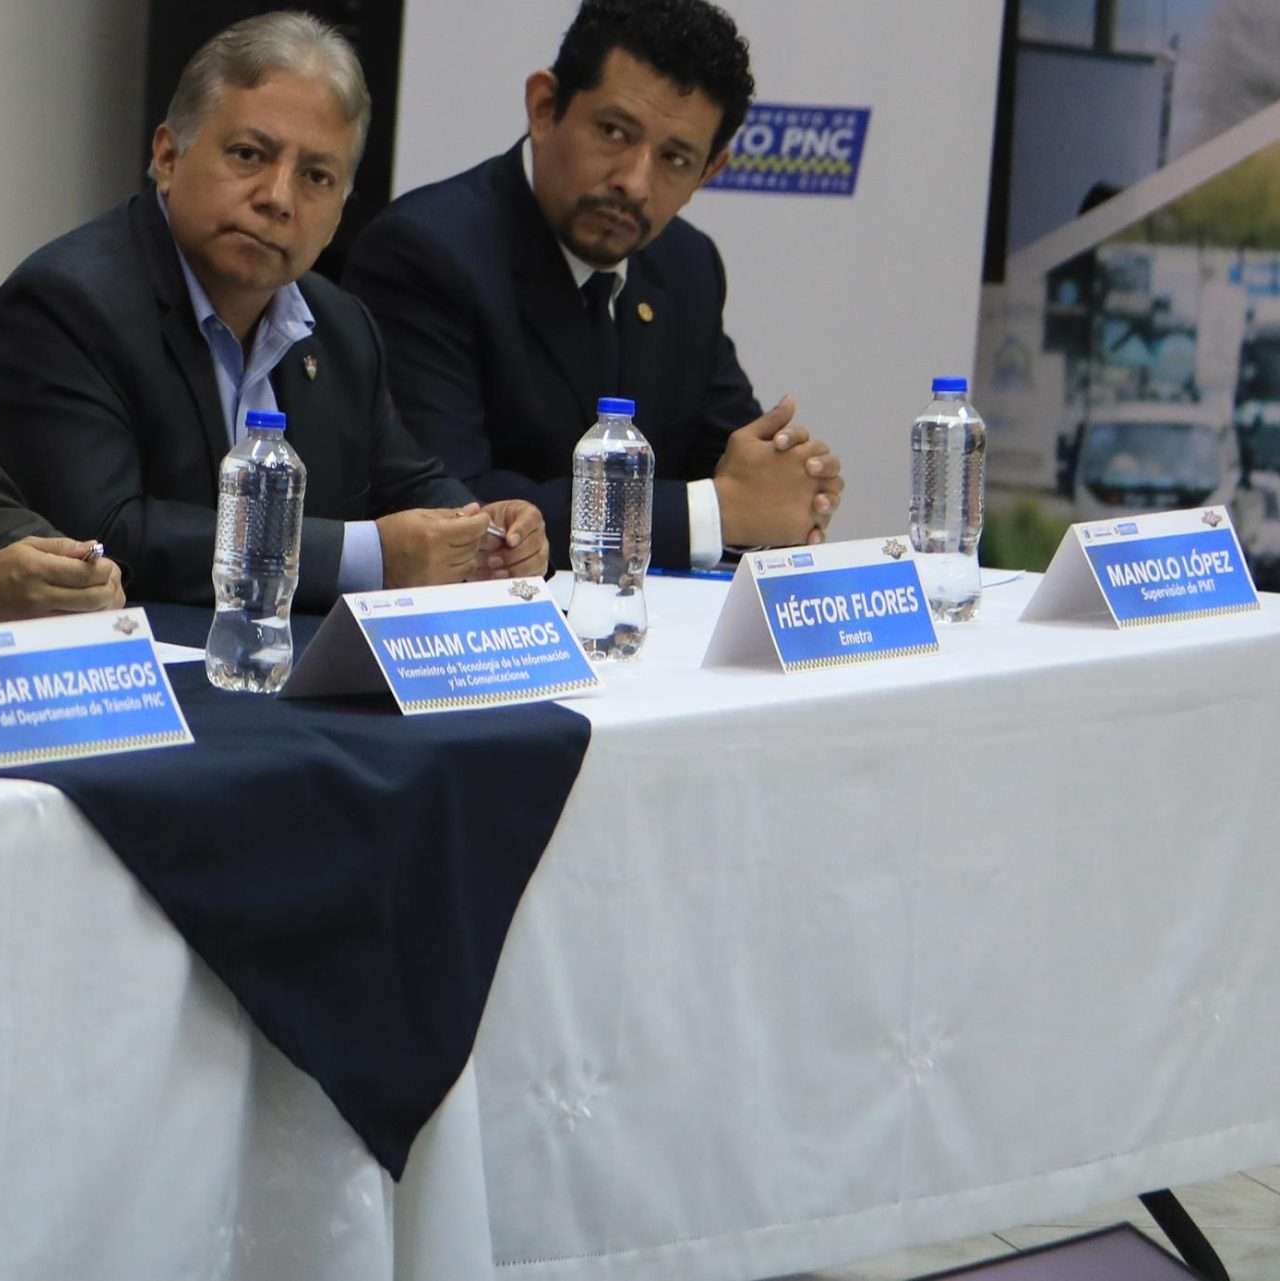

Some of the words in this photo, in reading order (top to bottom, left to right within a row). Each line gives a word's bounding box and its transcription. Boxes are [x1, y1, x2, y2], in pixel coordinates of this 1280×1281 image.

[780, 125, 853, 158] PNC
[1106, 557, 1180, 587] MANOLO
[1182, 548, 1233, 577] LÓPEZ
[775, 594, 849, 629] HÉCTOR
[852, 585, 919, 620] FLORES
[383, 632, 465, 661] WILLIAM
[467, 622, 560, 653] CAMEROS
[839, 630, 872, 646] Emetra
[34, 662, 156, 699] MAZARIEGOS
[142, 691, 165, 708] PNC
